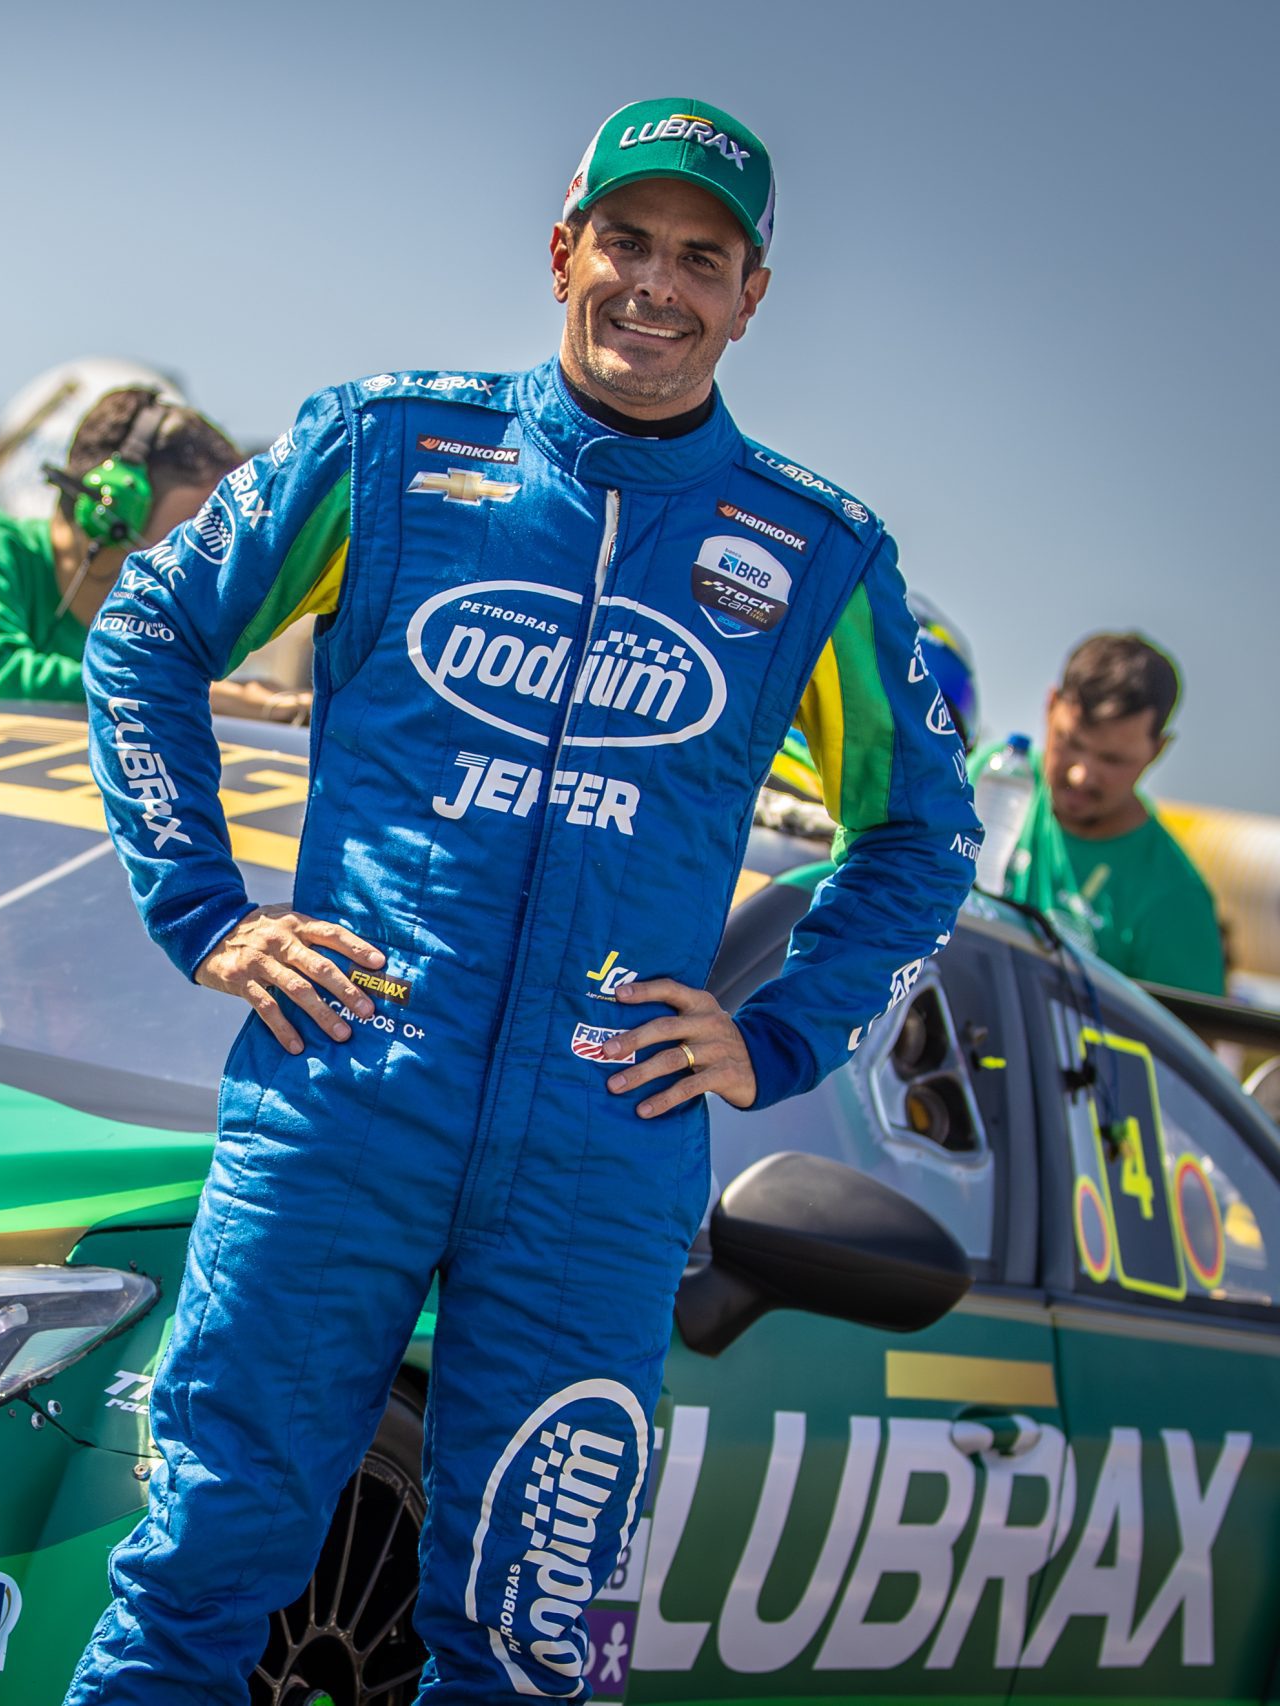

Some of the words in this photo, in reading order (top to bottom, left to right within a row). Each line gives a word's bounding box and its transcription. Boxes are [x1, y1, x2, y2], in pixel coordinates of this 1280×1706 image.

[619, 114, 750, 171] LUBRAX
[402, 376, 495, 396] LUBRAX
[226, 459, 273, 529] BRAX
[754, 450, 840, 498] LUBRAX
[712, 581, 775, 613] STOCK
[735, 560, 772, 589] BRB
[459, 600, 559, 635] PETROBRAS
[436, 624, 687, 722] podium
[108, 697, 193, 851] LUBRAX
[350, 970, 407, 999] FREMAX
[403, 1024, 426, 1040] O+
[1122, 1116, 1155, 1220] 4
[630, 1404, 1253, 1674] LUBRAX
